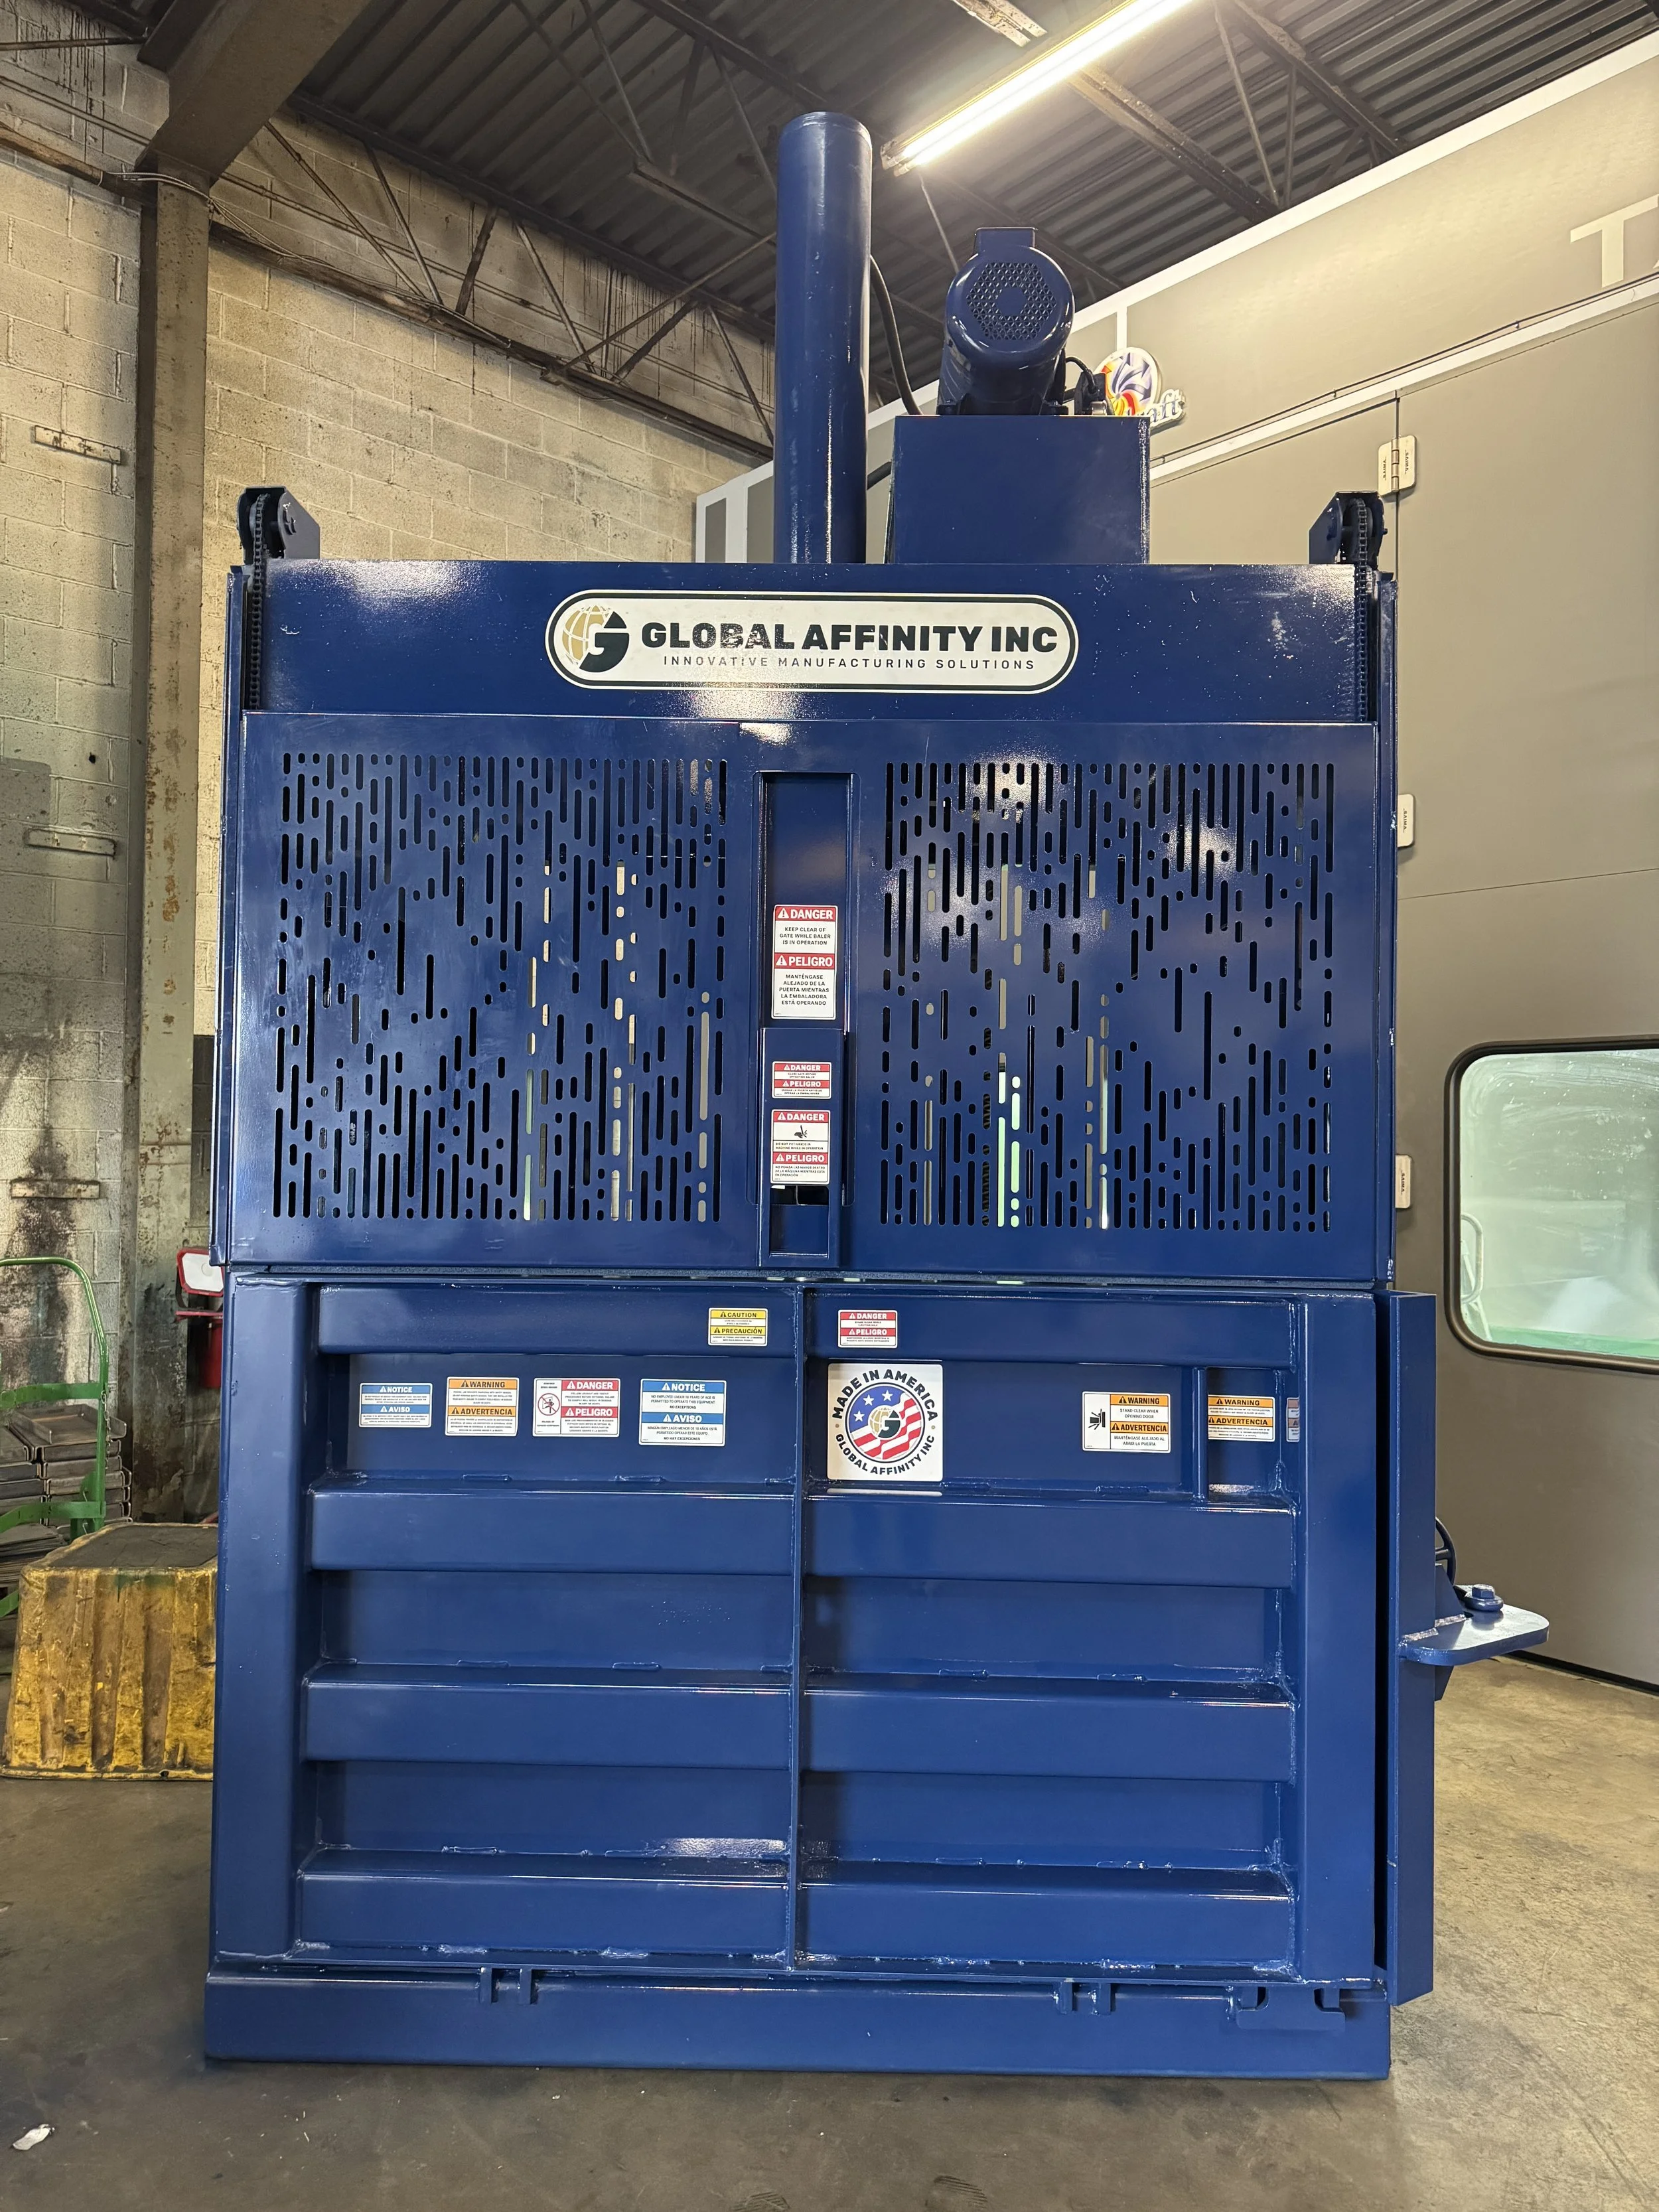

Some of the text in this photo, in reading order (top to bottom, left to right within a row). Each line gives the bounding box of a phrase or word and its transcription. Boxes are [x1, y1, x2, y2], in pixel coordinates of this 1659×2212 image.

[642, 623, 1058, 653] GLOBAL AFFINITY INC
[664, 656, 1034, 670] INNOVATIVE MANUFACTURING SOLUTIONS
[790, 909, 833, 920] DANGER
[789, 956, 833, 967] PELIGRO
[787, 1113, 825, 1121] DANGER
[577, 1381, 613, 1389] DANGER
[832, 1369, 938, 1421] MADE IN AMERICA
[575, 1408, 613, 1416] PELIGRO
[835, 1434, 935, 1475] GLOBAL AFFINITY INC
